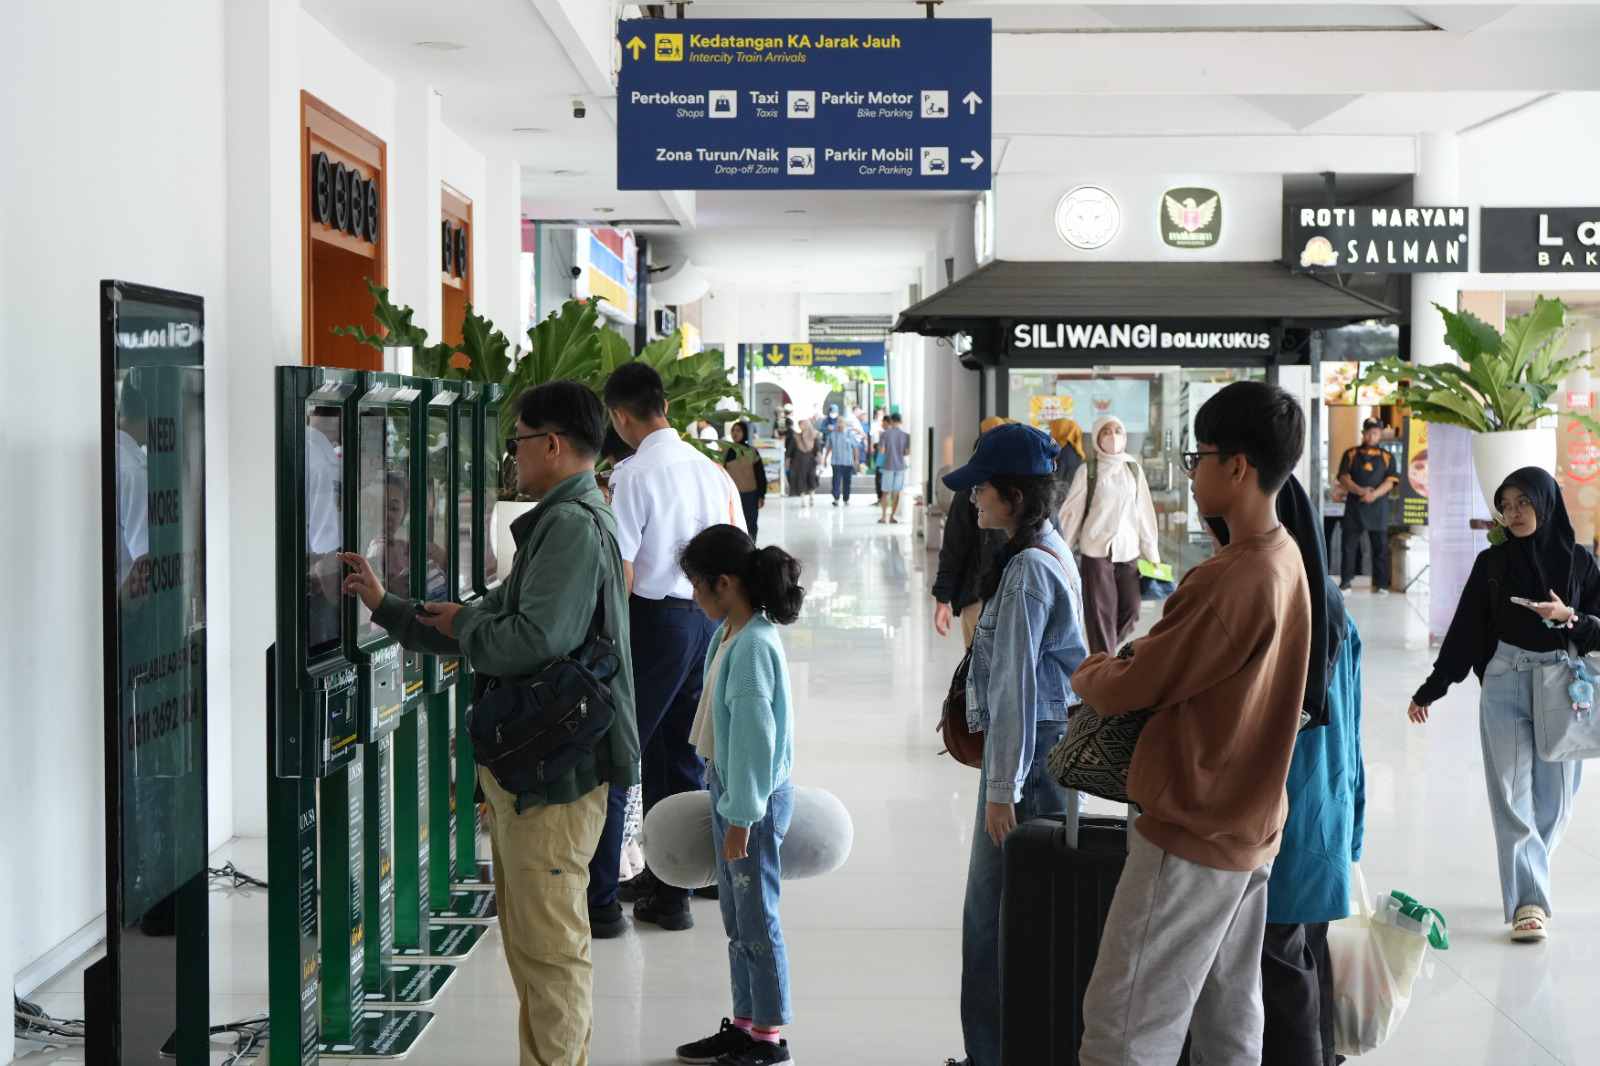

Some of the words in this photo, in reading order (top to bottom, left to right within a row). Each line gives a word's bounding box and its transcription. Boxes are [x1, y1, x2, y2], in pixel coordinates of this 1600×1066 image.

[690, 34, 783, 51] Kedatangan
[787, 34, 811, 48] KA
[815, 34, 859, 48] Jarak
[863, 34, 900, 48] Jauh
[689, 52, 733, 64] Intercity
[736, 52, 763, 63] Train
[764, 52, 807, 63] Arrivals
[631, 91, 705, 104] Pertokoan
[749, 91, 779, 104] Taxi
[821, 91, 865, 105] Parkir
[868, 91, 913, 104] Motor
[676, 108, 705, 119] Shops
[756, 108, 779, 118] Taxis
[857, 108, 876, 118] Bike
[879, 108, 913, 119] Parking
[656, 149, 692, 161] Zona
[696, 148, 779, 161] Turun/Naik
[825, 148, 867, 161] Parkir
[872, 148, 913, 161] Mobil
[715, 165, 753, 176] Drop-off
[755, 165, 779, 175] Zone
[859, 165, 876, 175] Car
[879, 165, 913, 176] Parking
[1301, 208, 1355, 227] ROTI
[1372, 208, 1464, 227] MARYAM
[1347, 239, 1459, 264] SALMAN
[1014, 323, 1158, 349] SILIWANGI
[1161, 332, 1270, 349] BOLUKUKUS
[148, 417, 176, 452] NEED
[148, 490, 179, 527] MORE
[128, 553, 188, 598] EXPOSUR
